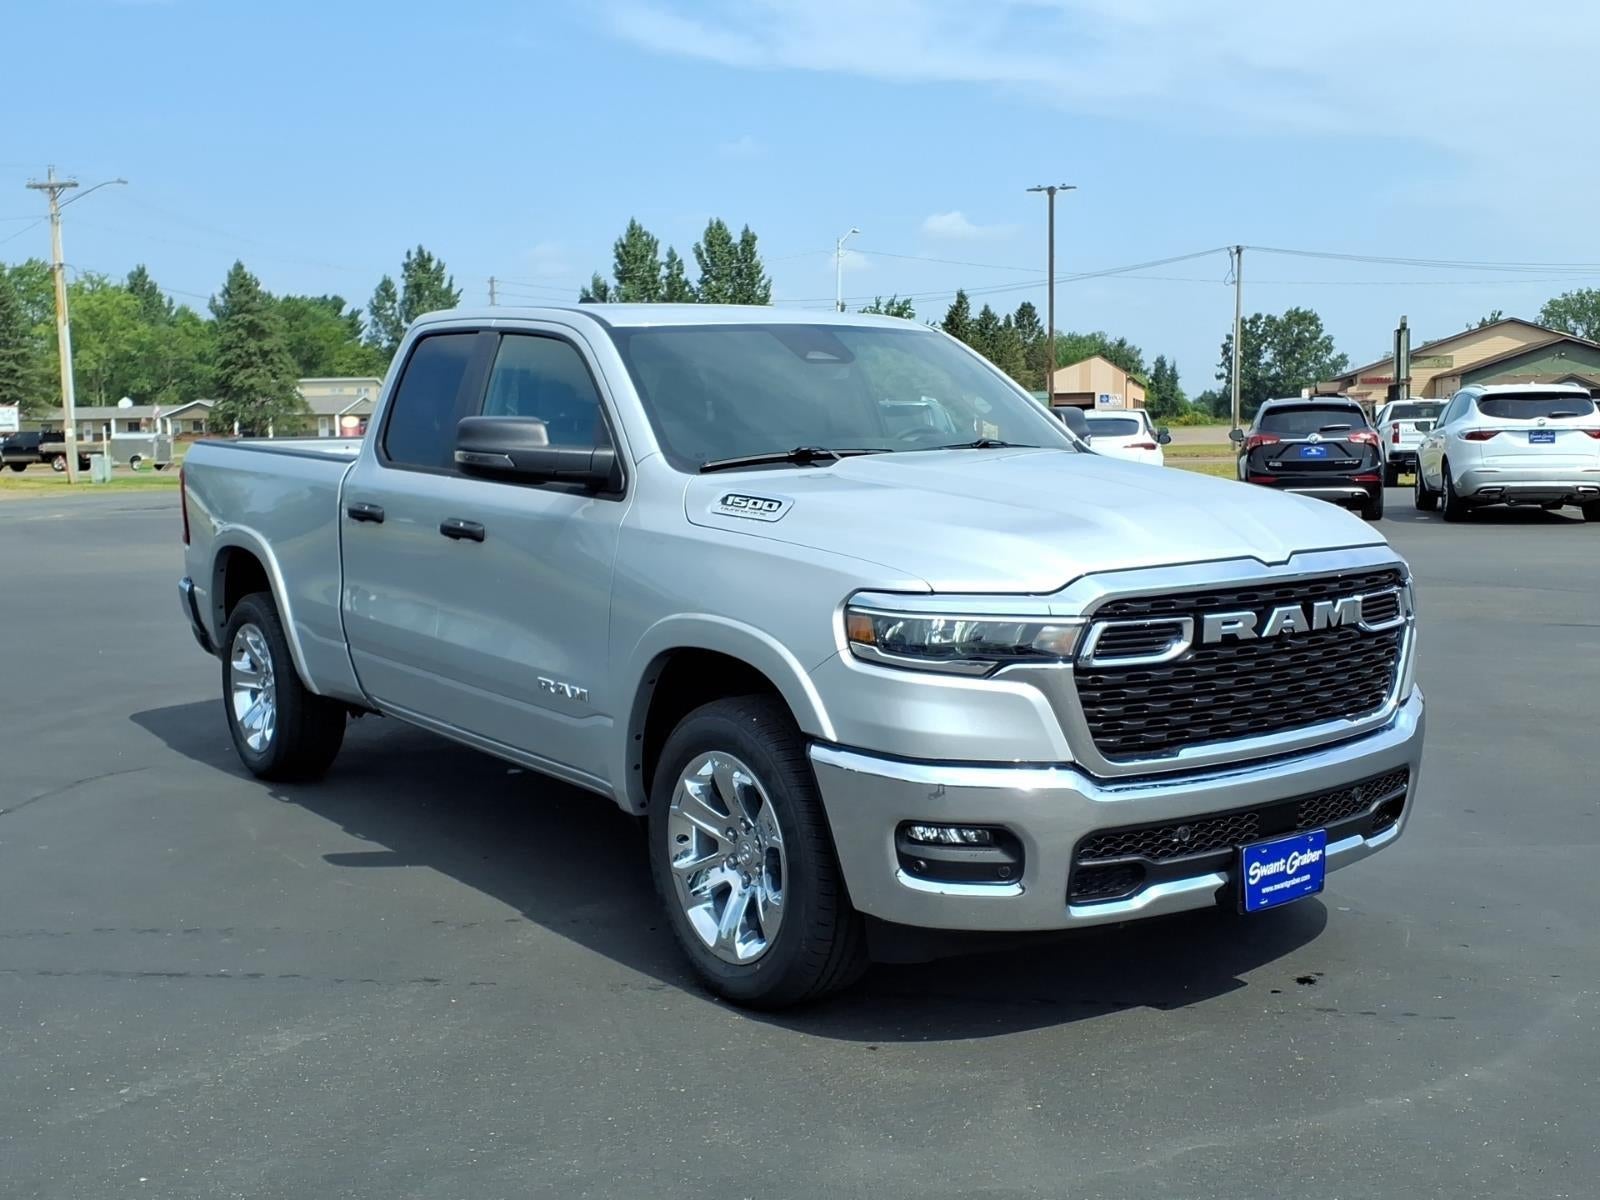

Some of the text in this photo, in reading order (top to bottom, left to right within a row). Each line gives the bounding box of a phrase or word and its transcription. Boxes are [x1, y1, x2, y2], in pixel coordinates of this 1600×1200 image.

[725, 495, 779, 511] 1500
[1203, 596, 1362, 643] RAM
[537, 676, 589, 703] RAM
[1248, 848, 1323, 885] Swant Graber
